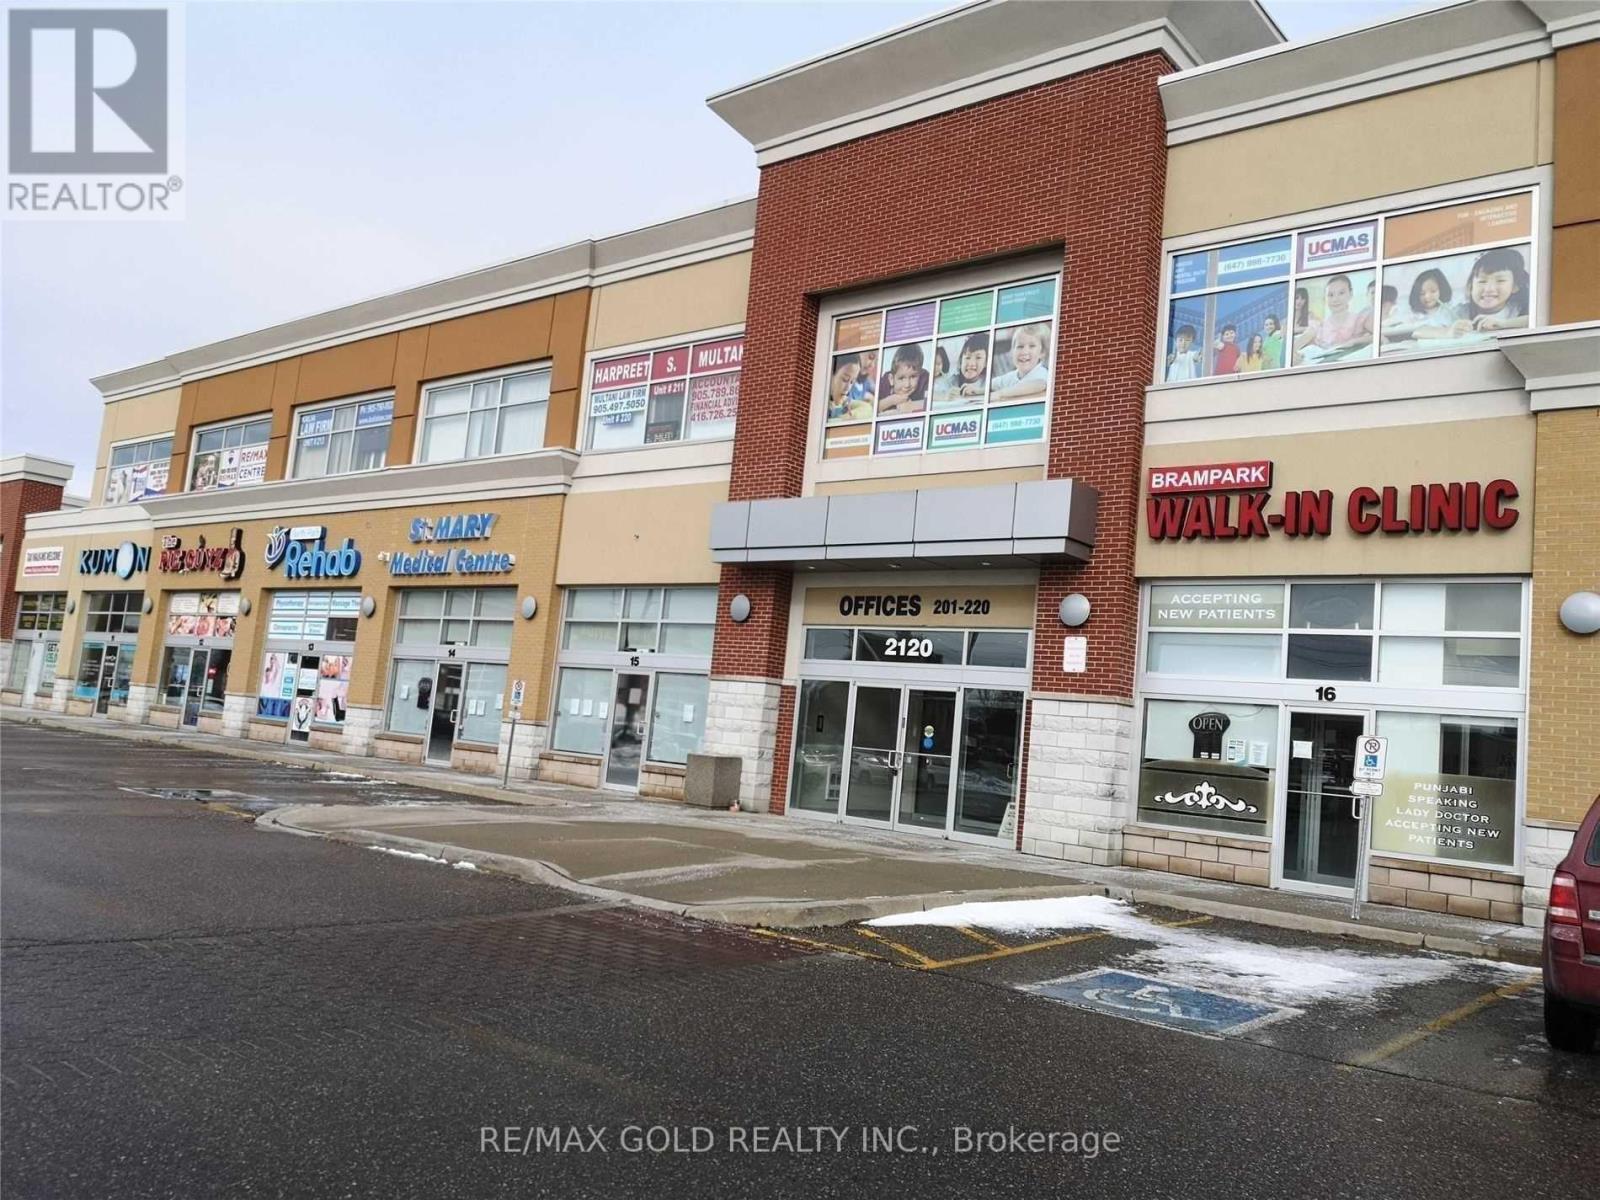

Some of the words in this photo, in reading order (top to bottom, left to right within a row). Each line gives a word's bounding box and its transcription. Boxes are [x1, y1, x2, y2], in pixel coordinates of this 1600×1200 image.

[1308, 233, 1370, 256] UCMAS
[595, 362, 650, 385] HARPREET
[666, 357, 677, 373] S.
[673, 382, 684, 392] 211
[593, 398, 646, 415] 905.497.5050
[881, 427, 920, 441] UCMAS
[936, 420, 977, 436] UCMAS
[238, 466, 265, 479] CENTRE
[1151, 465, 1267, 489] BRAMPARK
[1146, 489, 1333, 540] WALK-IN
[1347, 479, 1520, 535] CLINIC
[434, 513, 494, 540] MARY
[79, 541, 152, 581] KUMON
[284, 538, 359, 578] Rehab
[390, 549, 453, 576] Medical
[456, 549, 515, 575] Centre
[840, 594, 922, 617] OFFICES
[934, 599, 991, 615] 201-220
[1170, 593, 1262, 605] ACCEPTING
[1158, 609, 1194, 619] NEW
[1198, 608, 1276, 619] PATIENTS
[448, 649, 456, 658] 14
[885, 638, 933, 658] 2120
[630, 656, 640, 667] 15
[1315, 687, 1336, 701] 16
[1192, 717, 1224, 731] OPEN
[1414, 782, 1474, 796] PUNJABI
[1407, 795, 1479, 809] SPEAKING
[1396, 806, 1430, 817] LADY
[1434, 811, 1490, 824] DOCTOR
[1385, 819, 1462, 834] ACCEPTING
[1467, 827, 1500, 838] NEW
[1408, 834, 1475, 849] PATIENTS
